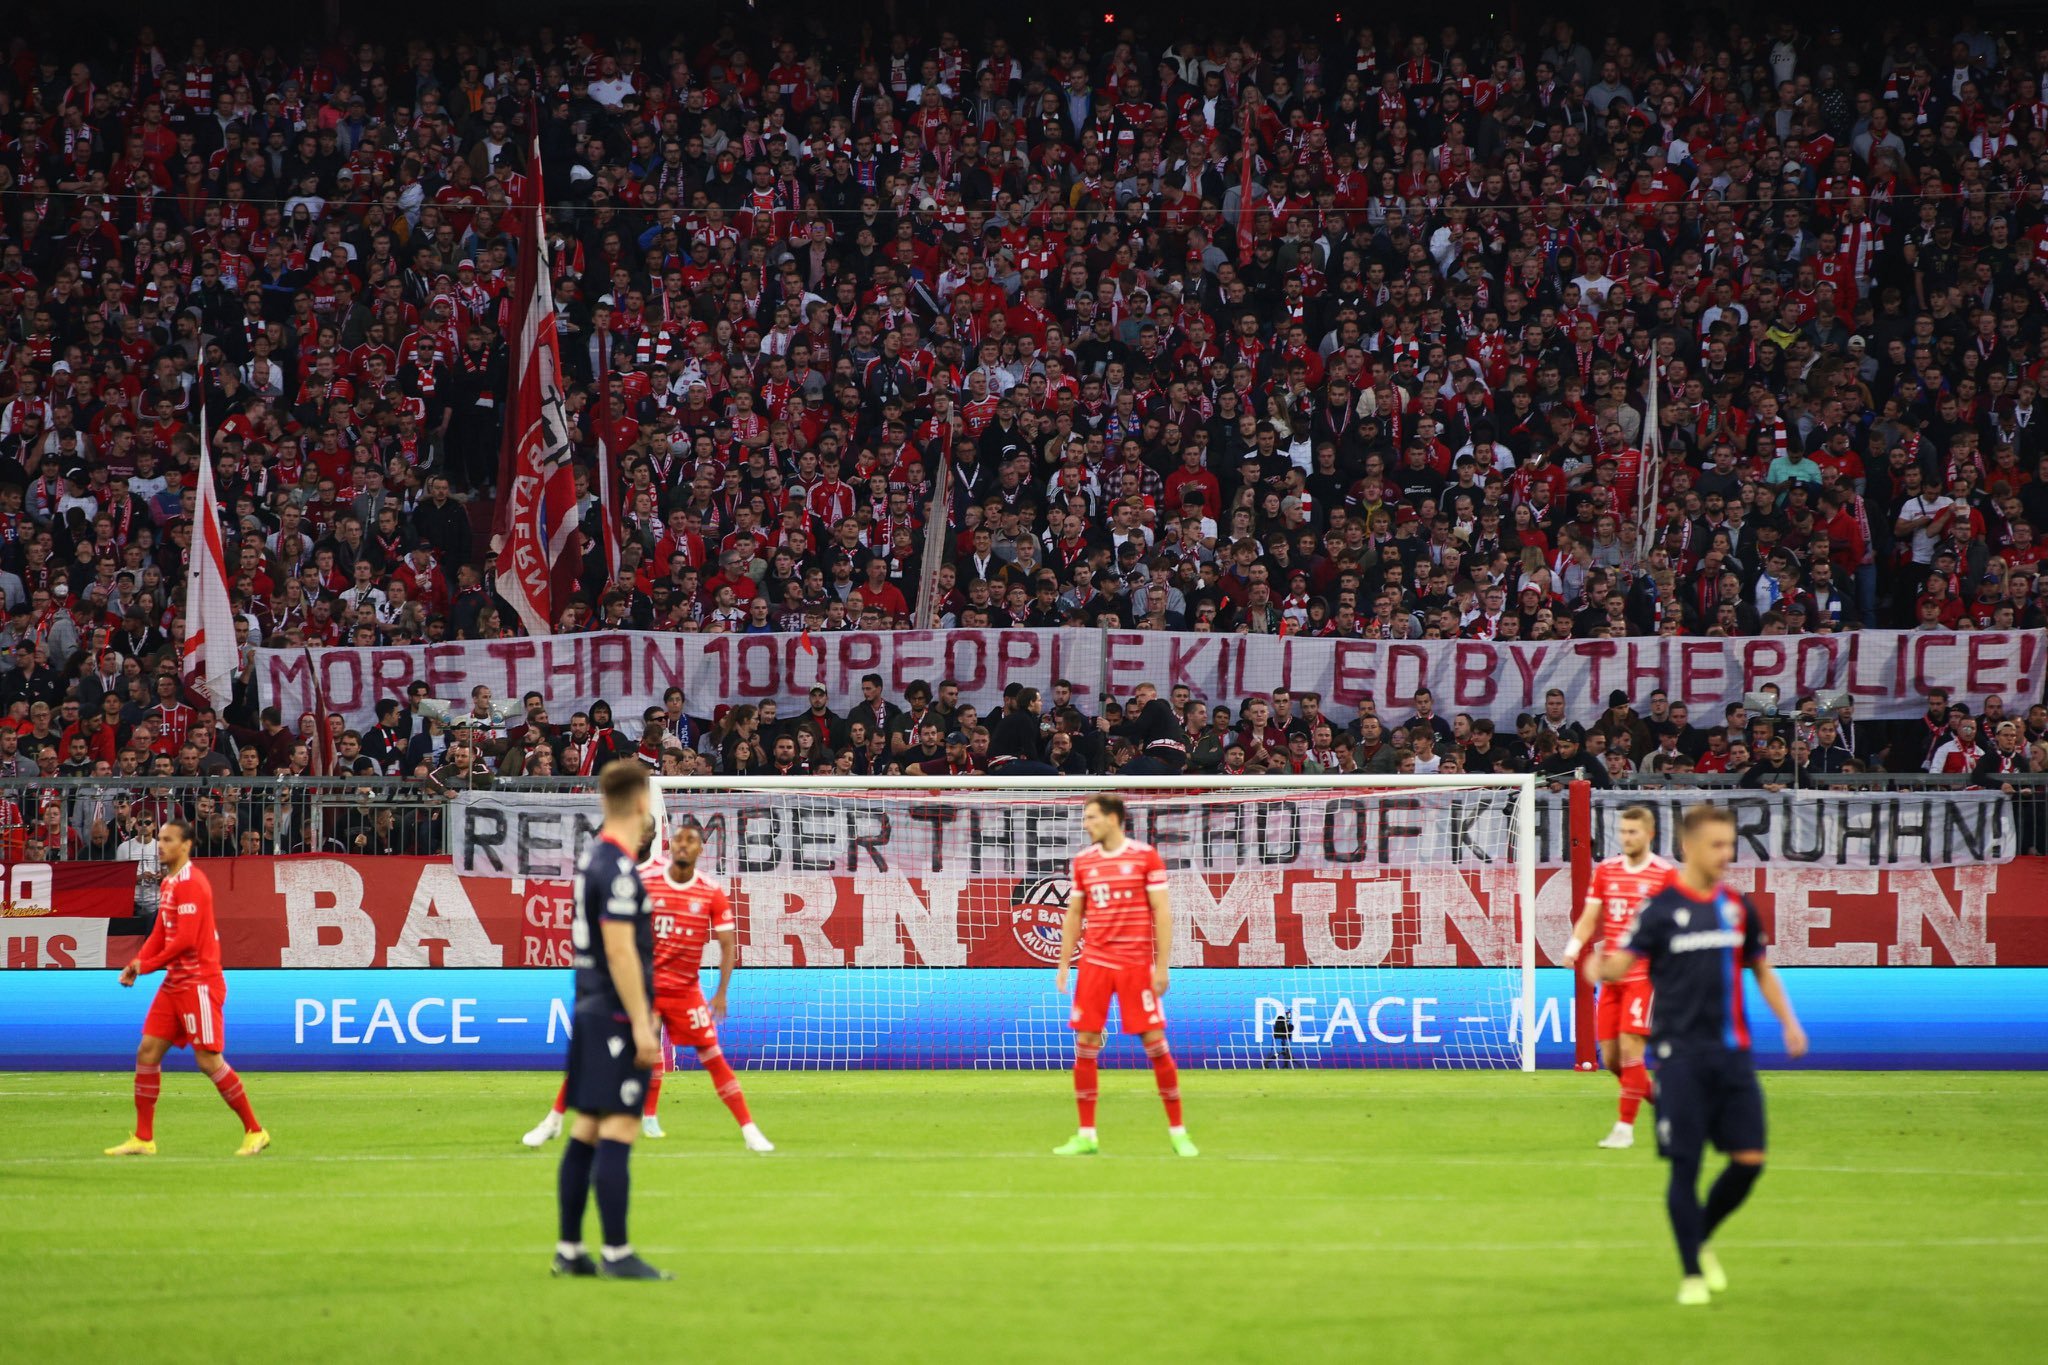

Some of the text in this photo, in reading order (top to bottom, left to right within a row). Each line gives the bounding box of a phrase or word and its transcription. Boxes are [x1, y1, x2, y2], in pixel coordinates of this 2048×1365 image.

[270, 644, 466, 711] MORE
[488, 635, 685, 699] THAN
[703, 635, 826, 698] 100
[839, 630, 1144, 697] PEOPLE
[1168, 636, 1429, 708] KILLED
[1454, 642, 1548, 708] BY
[1574, 640, 1723, 706] THE
[1743, 633, 2035, 699] POLICE!
[910, 804, 1070, 875] THE
[1124, 800, 1300, 870] EAD
[1324, 799, 1422, 864] OF
[295, 998, 480, 1043] PEACE
[1254, 997, 1441, 1043] PEACE
